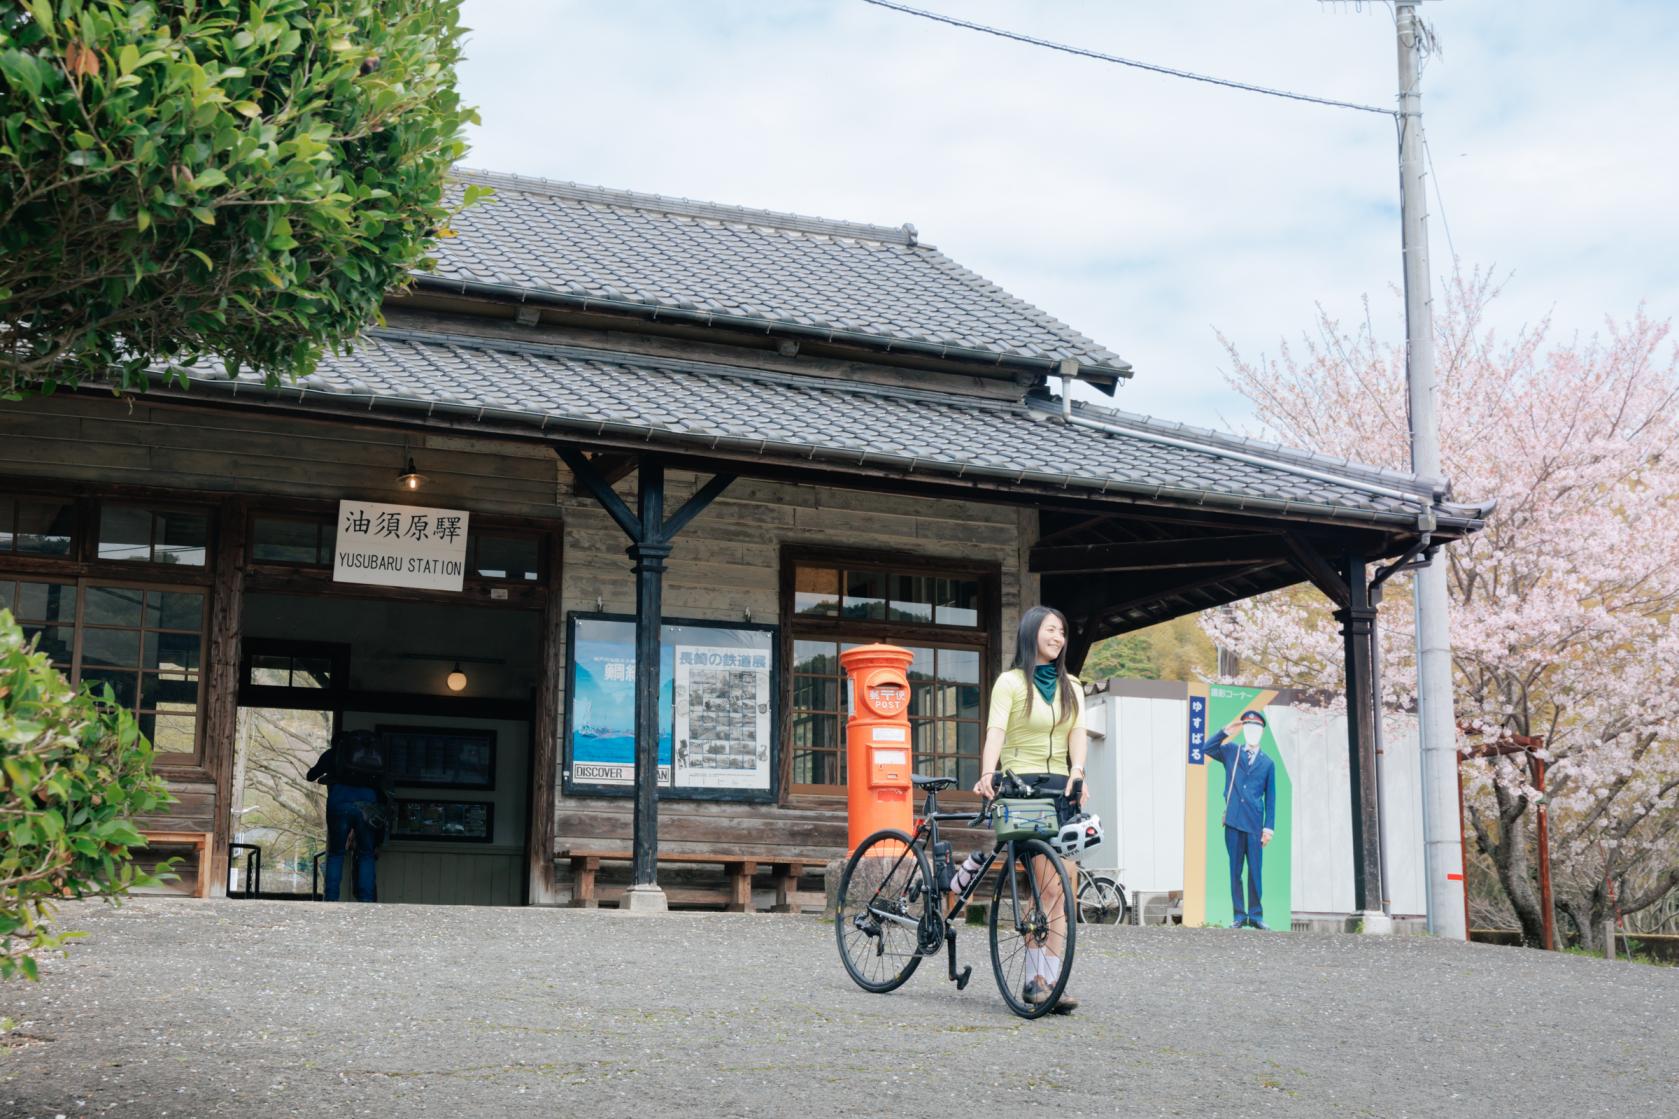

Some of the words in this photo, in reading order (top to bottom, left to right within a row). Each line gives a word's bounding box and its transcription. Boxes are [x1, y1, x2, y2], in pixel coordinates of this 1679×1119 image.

[345, 510, 462, 544] 油須原驛
[339, 552, 403, 571] YUSUBARU
[408, 558, 462, 576] STATION
[875, 701, 901, 709] POST
[1191, 702, 1203, 760] ゆすばる
[576, 766, 623, 779] DISCOVER
